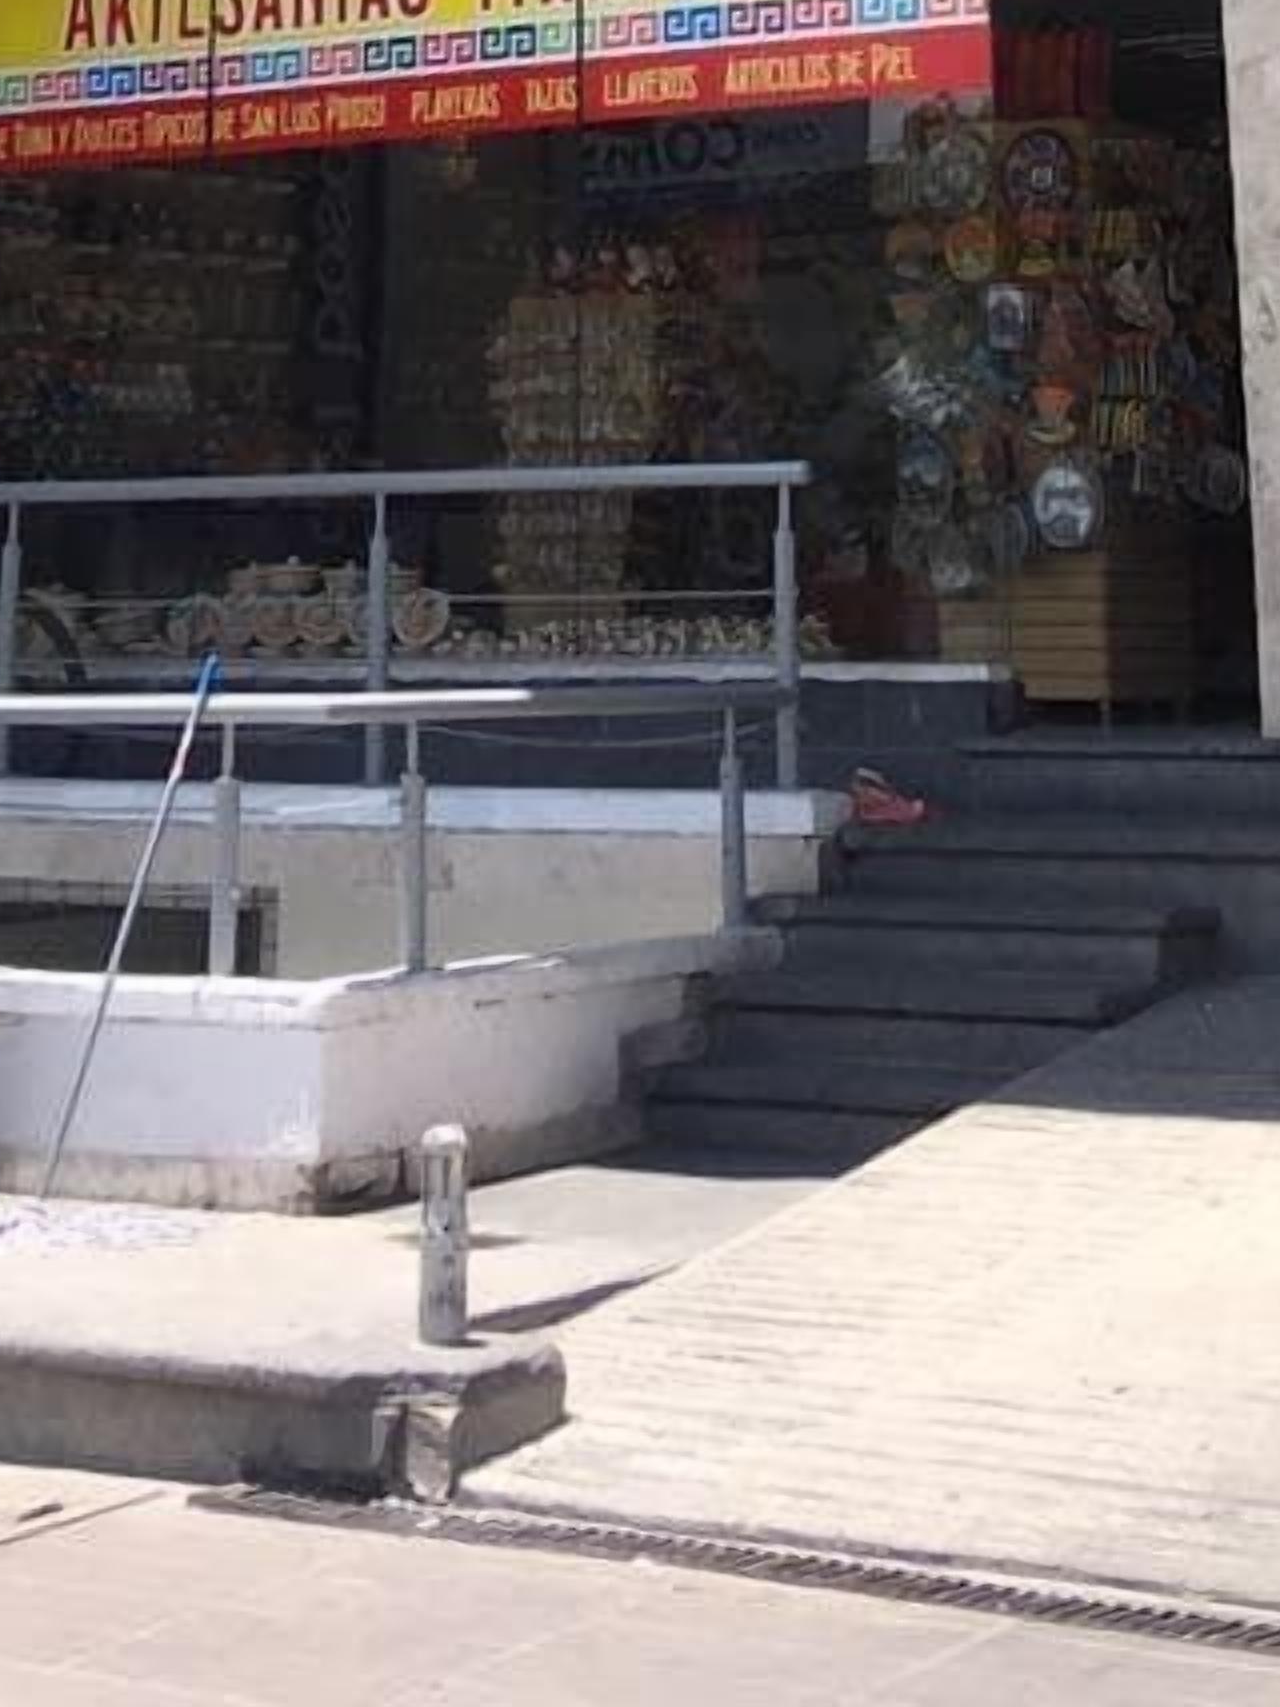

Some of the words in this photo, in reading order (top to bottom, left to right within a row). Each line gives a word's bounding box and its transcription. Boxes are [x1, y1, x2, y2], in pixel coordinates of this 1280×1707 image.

[871, 43, 918, 84] PIEL
[239, 101, 276, 140] SAN
[279, 98, 321, 134] LUIS
